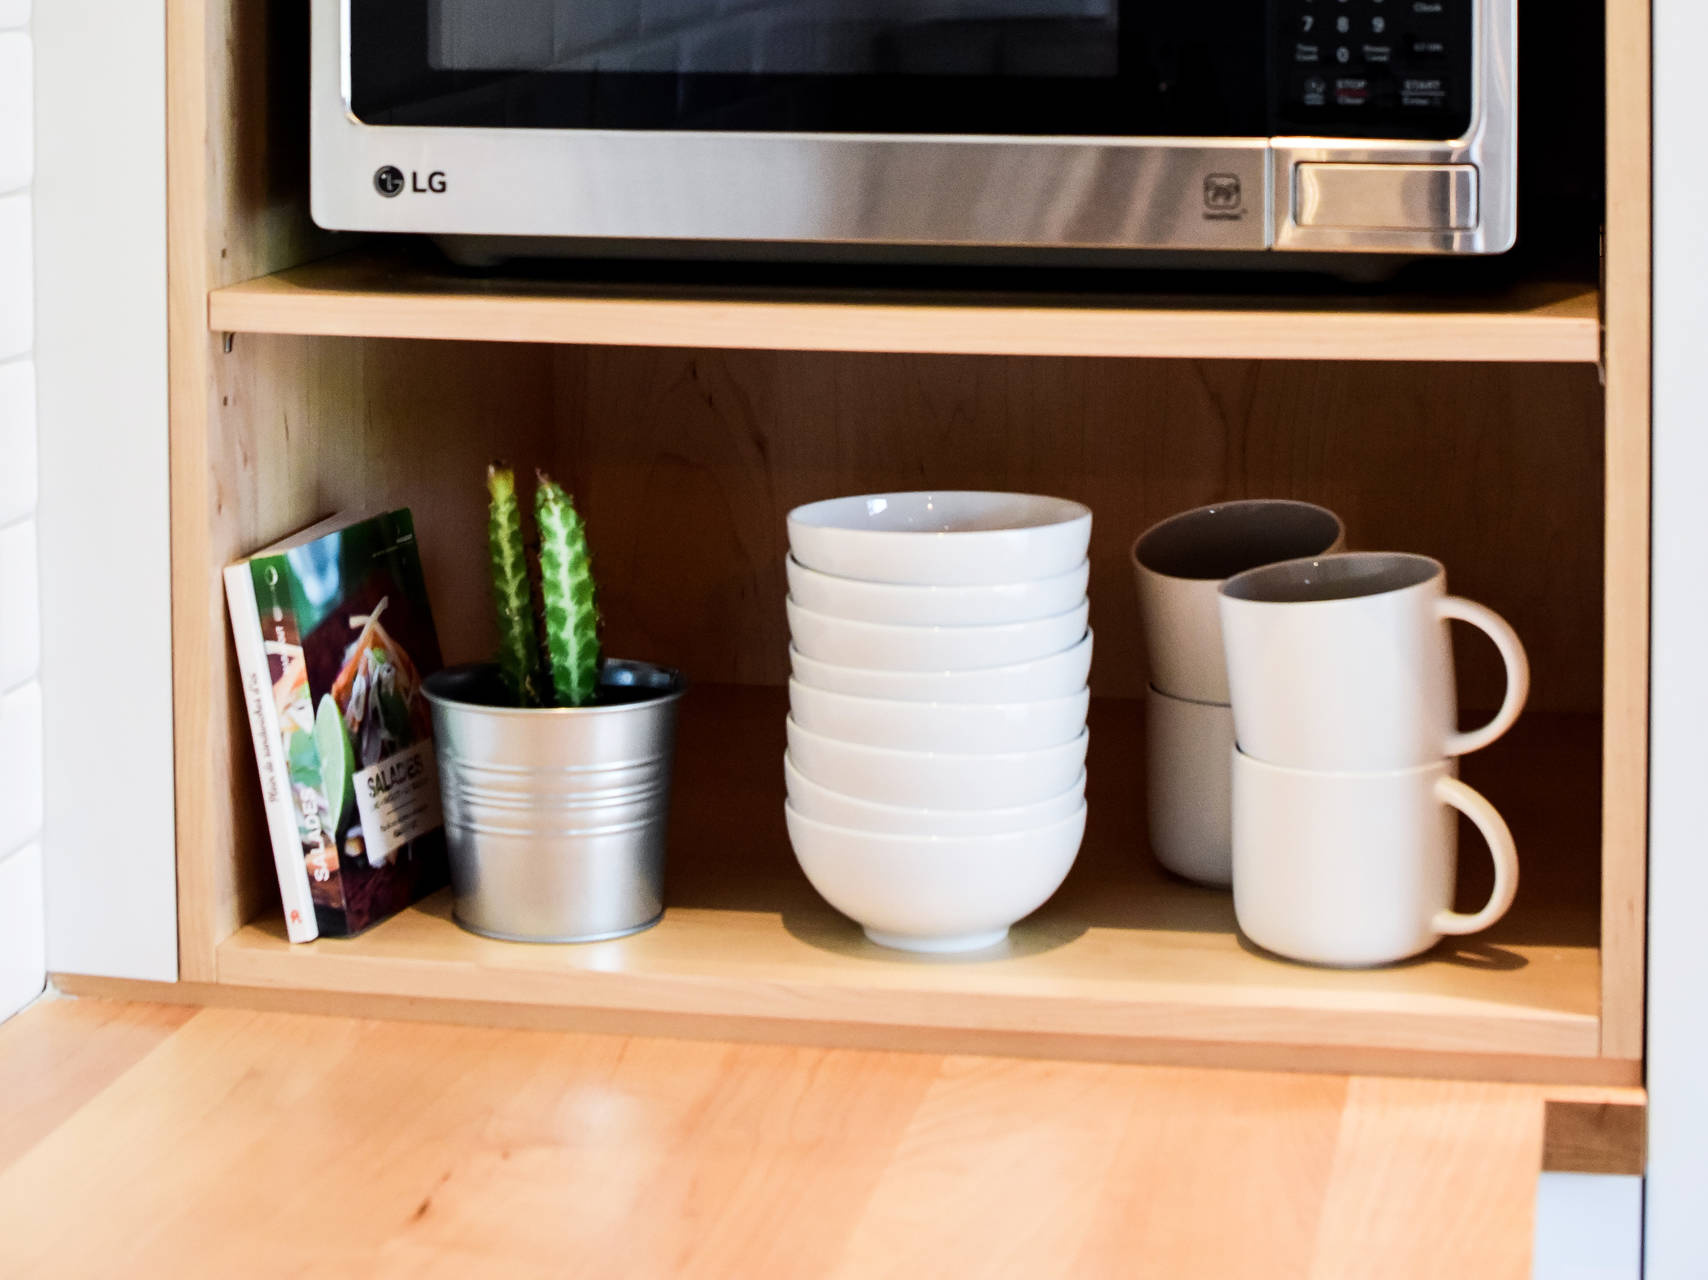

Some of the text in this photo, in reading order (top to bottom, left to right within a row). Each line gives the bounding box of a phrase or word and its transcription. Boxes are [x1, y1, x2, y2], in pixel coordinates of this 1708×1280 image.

[1301, 16, 1314, 32] 7
[1336, 15, 1350, 33] 8
[1371, 16, 1385, 33] 9
[1336, 46, 1350, 63] 0
[412, 171, 447, 193] LG
[302, 788, 330, 882] SALADES
